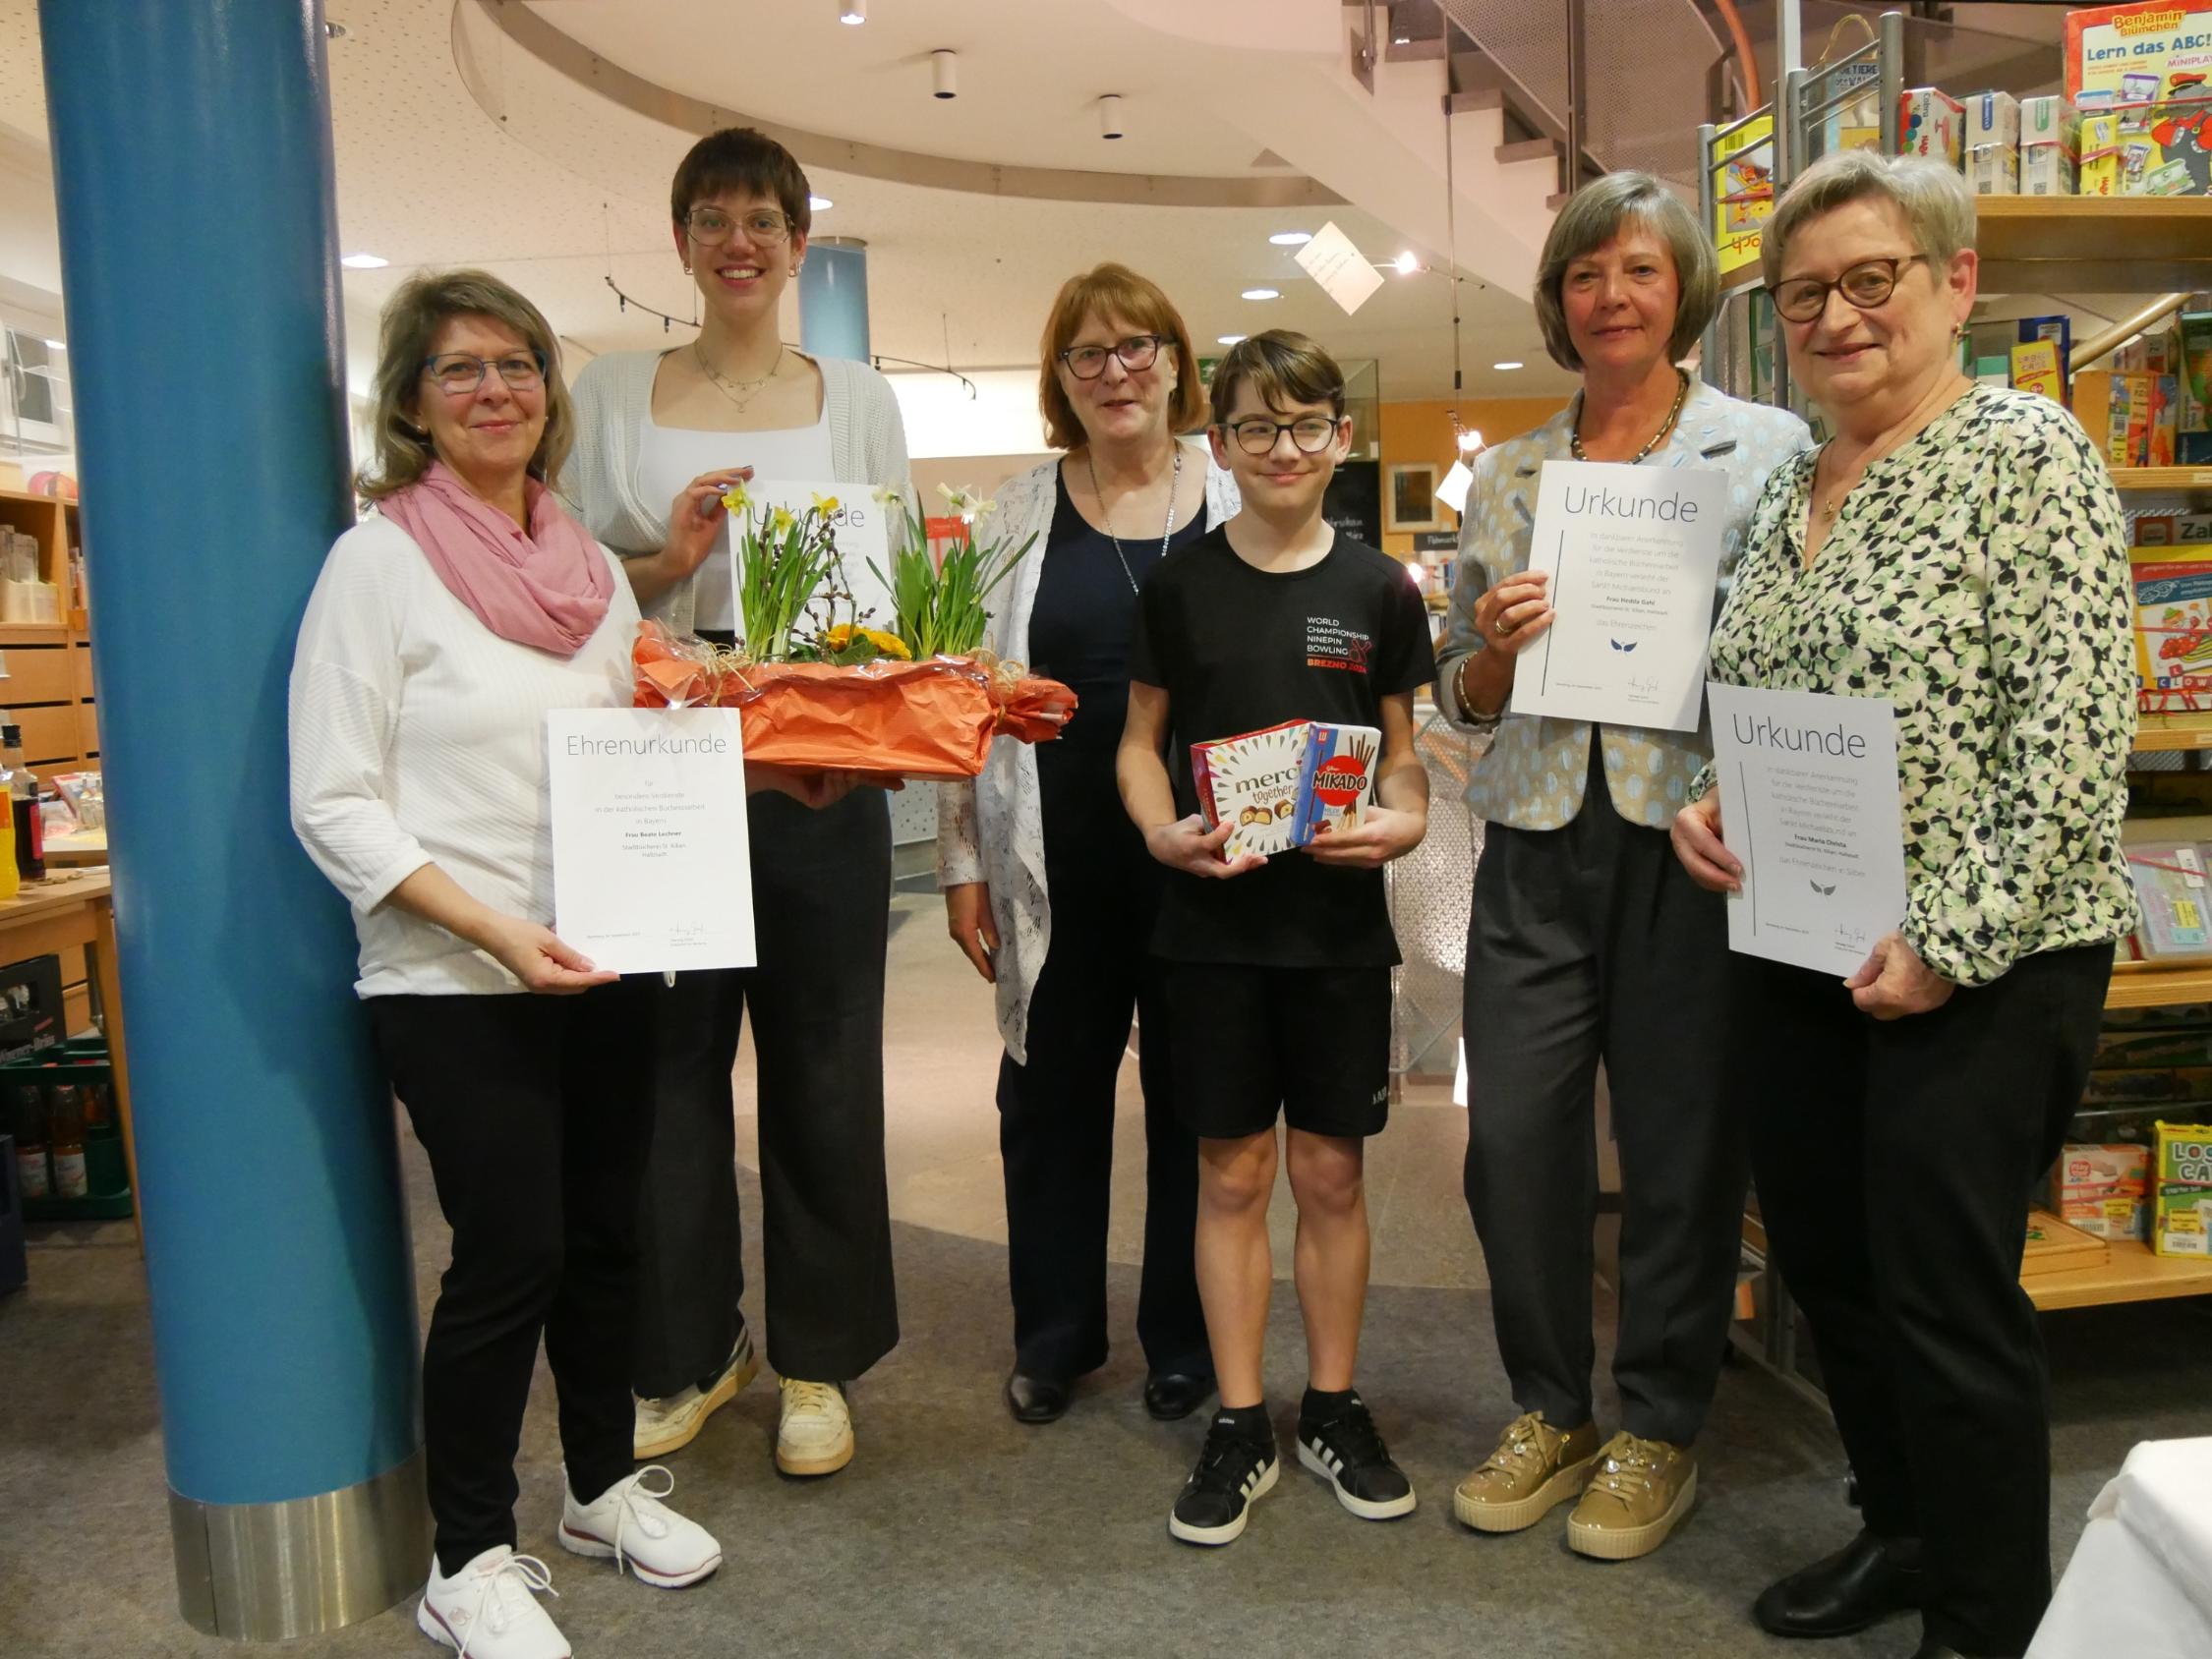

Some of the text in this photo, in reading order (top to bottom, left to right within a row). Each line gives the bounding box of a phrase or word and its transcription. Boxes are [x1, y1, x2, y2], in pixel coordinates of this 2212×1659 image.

[2113, 11, 2183, 29] Benjamin
[2120, 22, 2179, 36] Blümchen
[2087, 33, 2212, 61] Lern das ABC!
[1564, 486, 1698, 523] Urkunde
[1307, 616, 1339, 627] WORLD
[1307, 626, 1369, 641] CHAMPIONSHIP
[1307, 635, 1343, 646] NINEPIN
[1307, 645, 1349, 656] BOWLING
[1307, 658, 1347, 669] BREZNO
[567, 733, 727, 756] Ehrenurkunde
[1318, 731, 1327, 742] LU
[1733, 714, 1866, 758] Urkunde
[1236, 761, 1302, 794] merc
[1311, 771, 1368, 791] MIKADO
[1252, 785, 1295, 804] together
